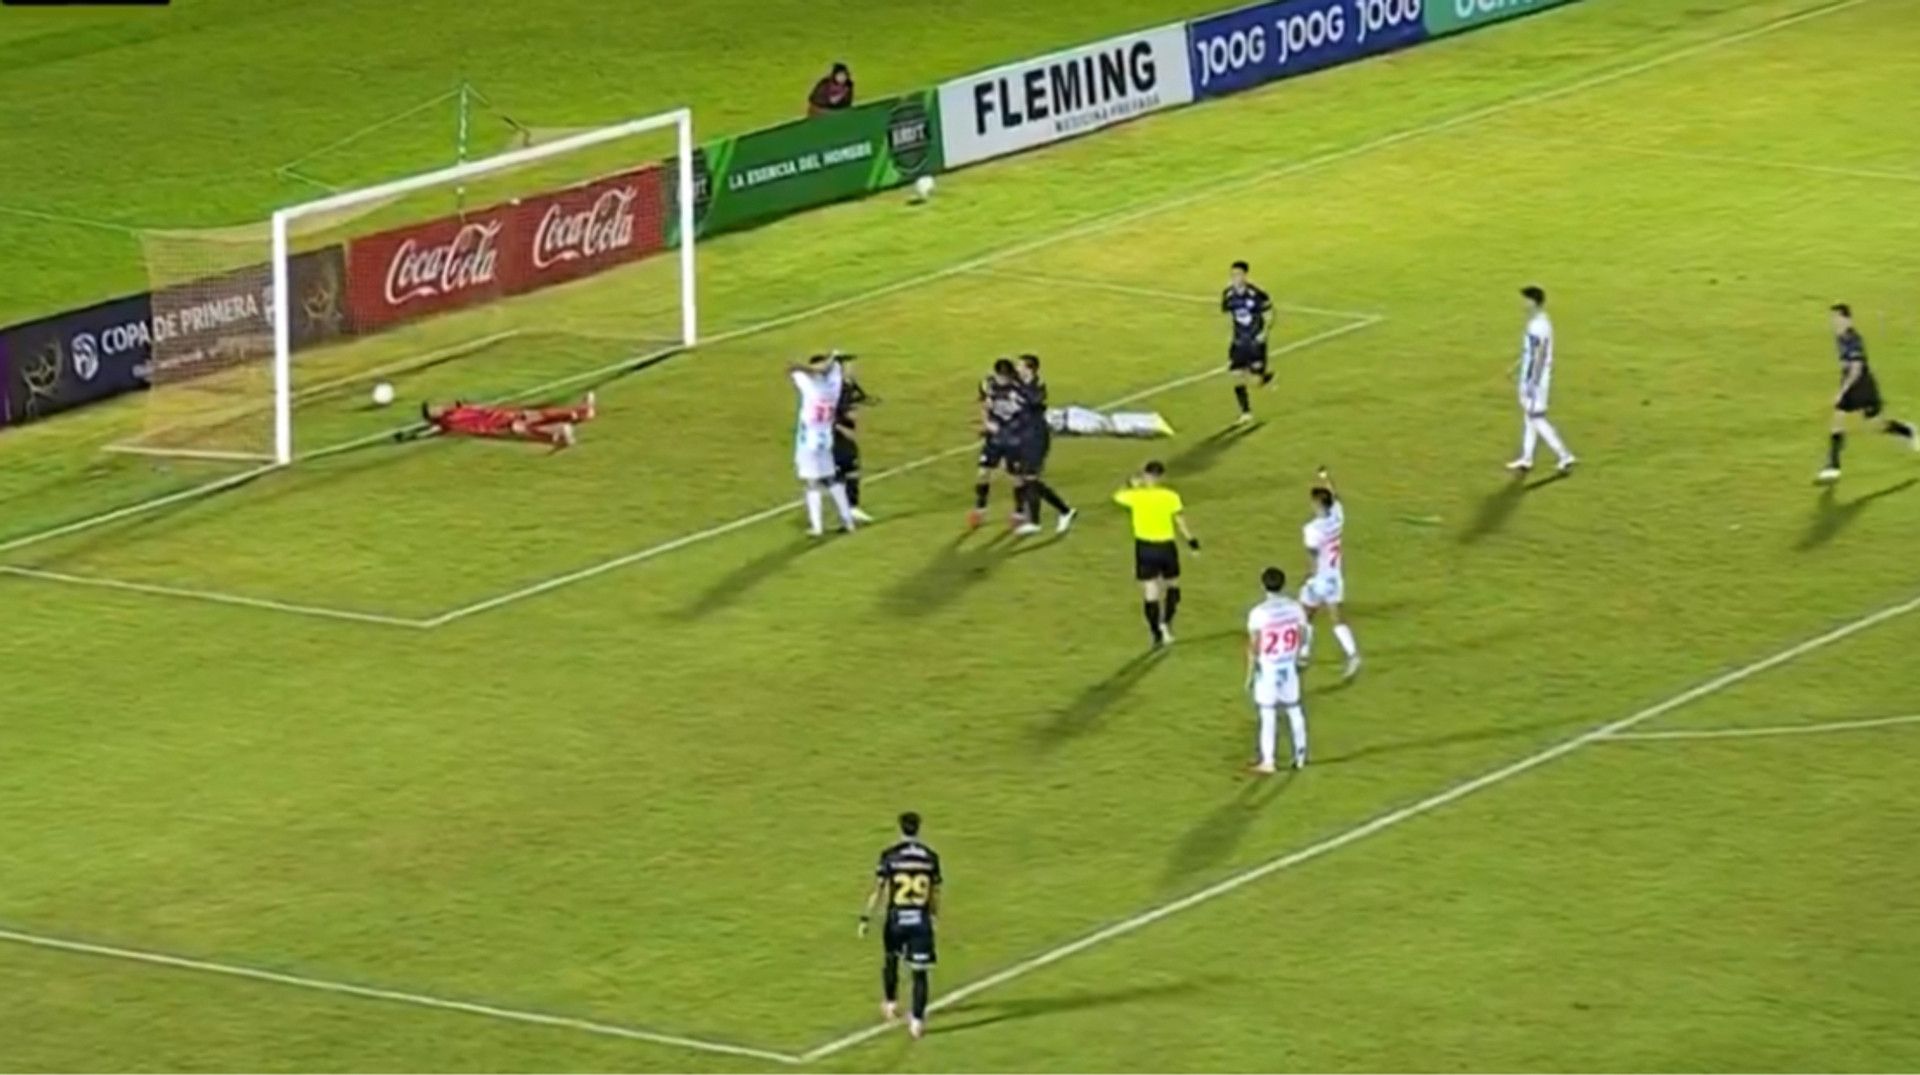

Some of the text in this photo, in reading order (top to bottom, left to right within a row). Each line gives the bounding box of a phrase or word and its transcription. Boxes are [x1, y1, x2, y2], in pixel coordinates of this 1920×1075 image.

[1197, 0, 1421, 86] JOOG JOOG JOOG
[974, 40, 1157, 136] FLEMING
[728, 173, 745, 190] LA
[746, 159, 798, 186] ESENCIA
[798, 153, 821, 173] DEL
[101, 293, 259, 355] COPA DE PRIMERA
[1264, 627, 1298, 655] 29
[893, 872, 931, 906] 29
